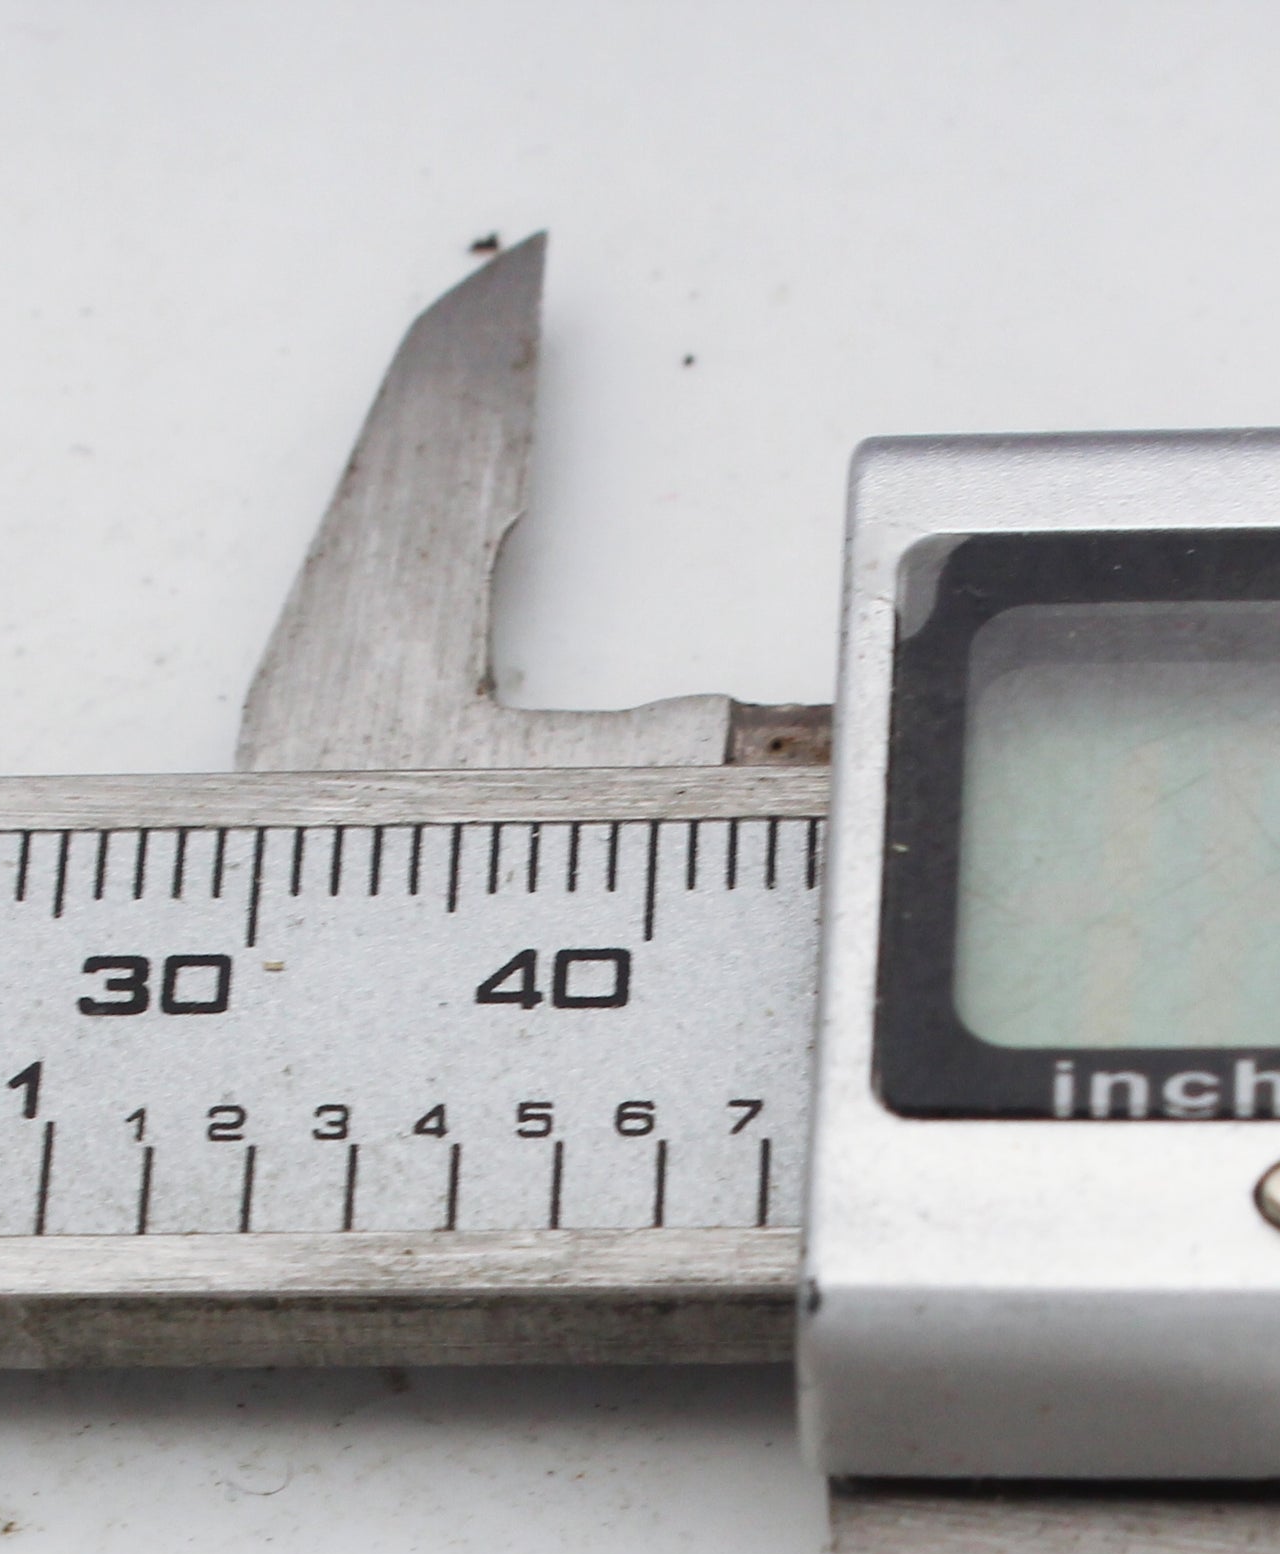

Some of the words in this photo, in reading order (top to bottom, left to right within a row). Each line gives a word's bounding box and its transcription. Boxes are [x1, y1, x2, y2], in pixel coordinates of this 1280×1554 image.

[76, 954, 233, 1016] 30
[475, 947, 631, 1009] 40
[7, 1060, 42, 1119] 1
[125, 1107, 148, 1142] 1
[206, 1105, 247, 1141] 2
[312, 1104, 350, 1140] 3
[413, 1103, 448, 1139] 4
[516, 1102, 555, 1138] 5
[615, 1101, 655, 1137] 6
[728, 1099, 764, 1135] 7
